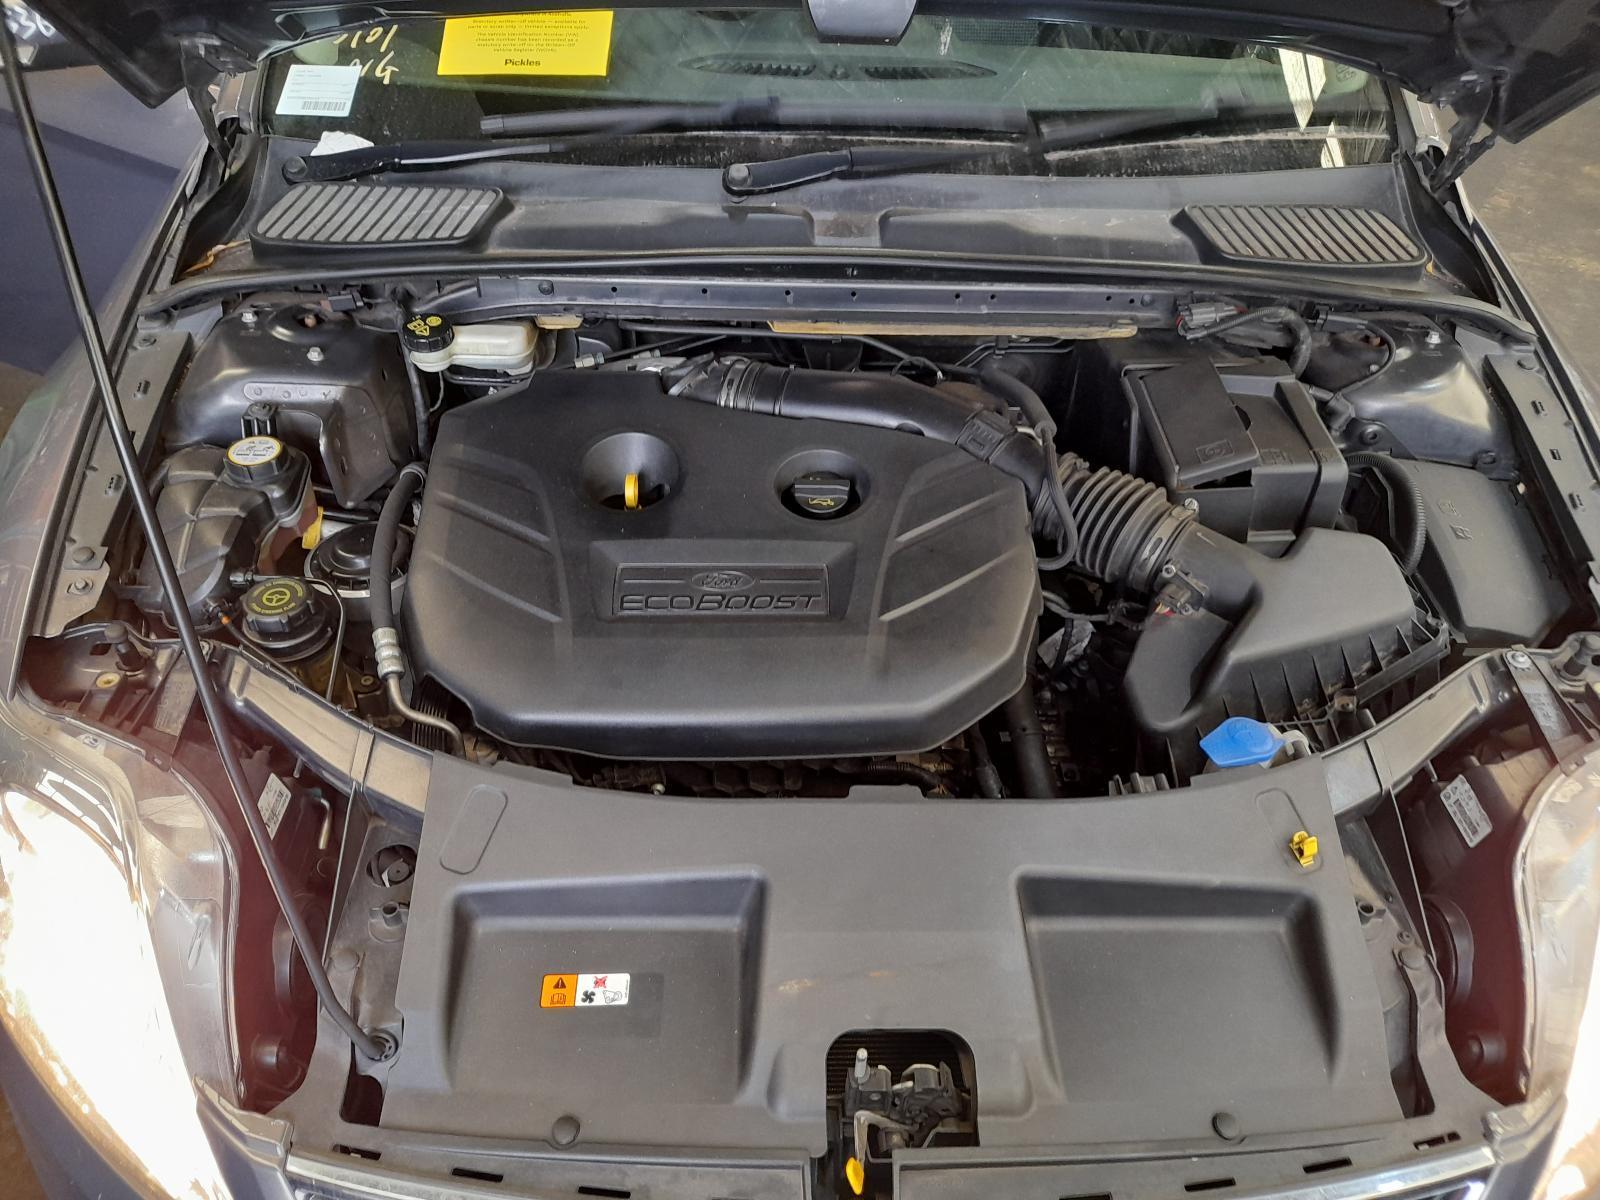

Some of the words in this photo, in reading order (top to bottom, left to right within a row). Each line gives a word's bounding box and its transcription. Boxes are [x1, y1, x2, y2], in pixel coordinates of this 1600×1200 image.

[504, 58, 541, 67] Pickles
[700, 572, 743, 589] Ford
[620, 594, 822, 611] ECOBOOST
